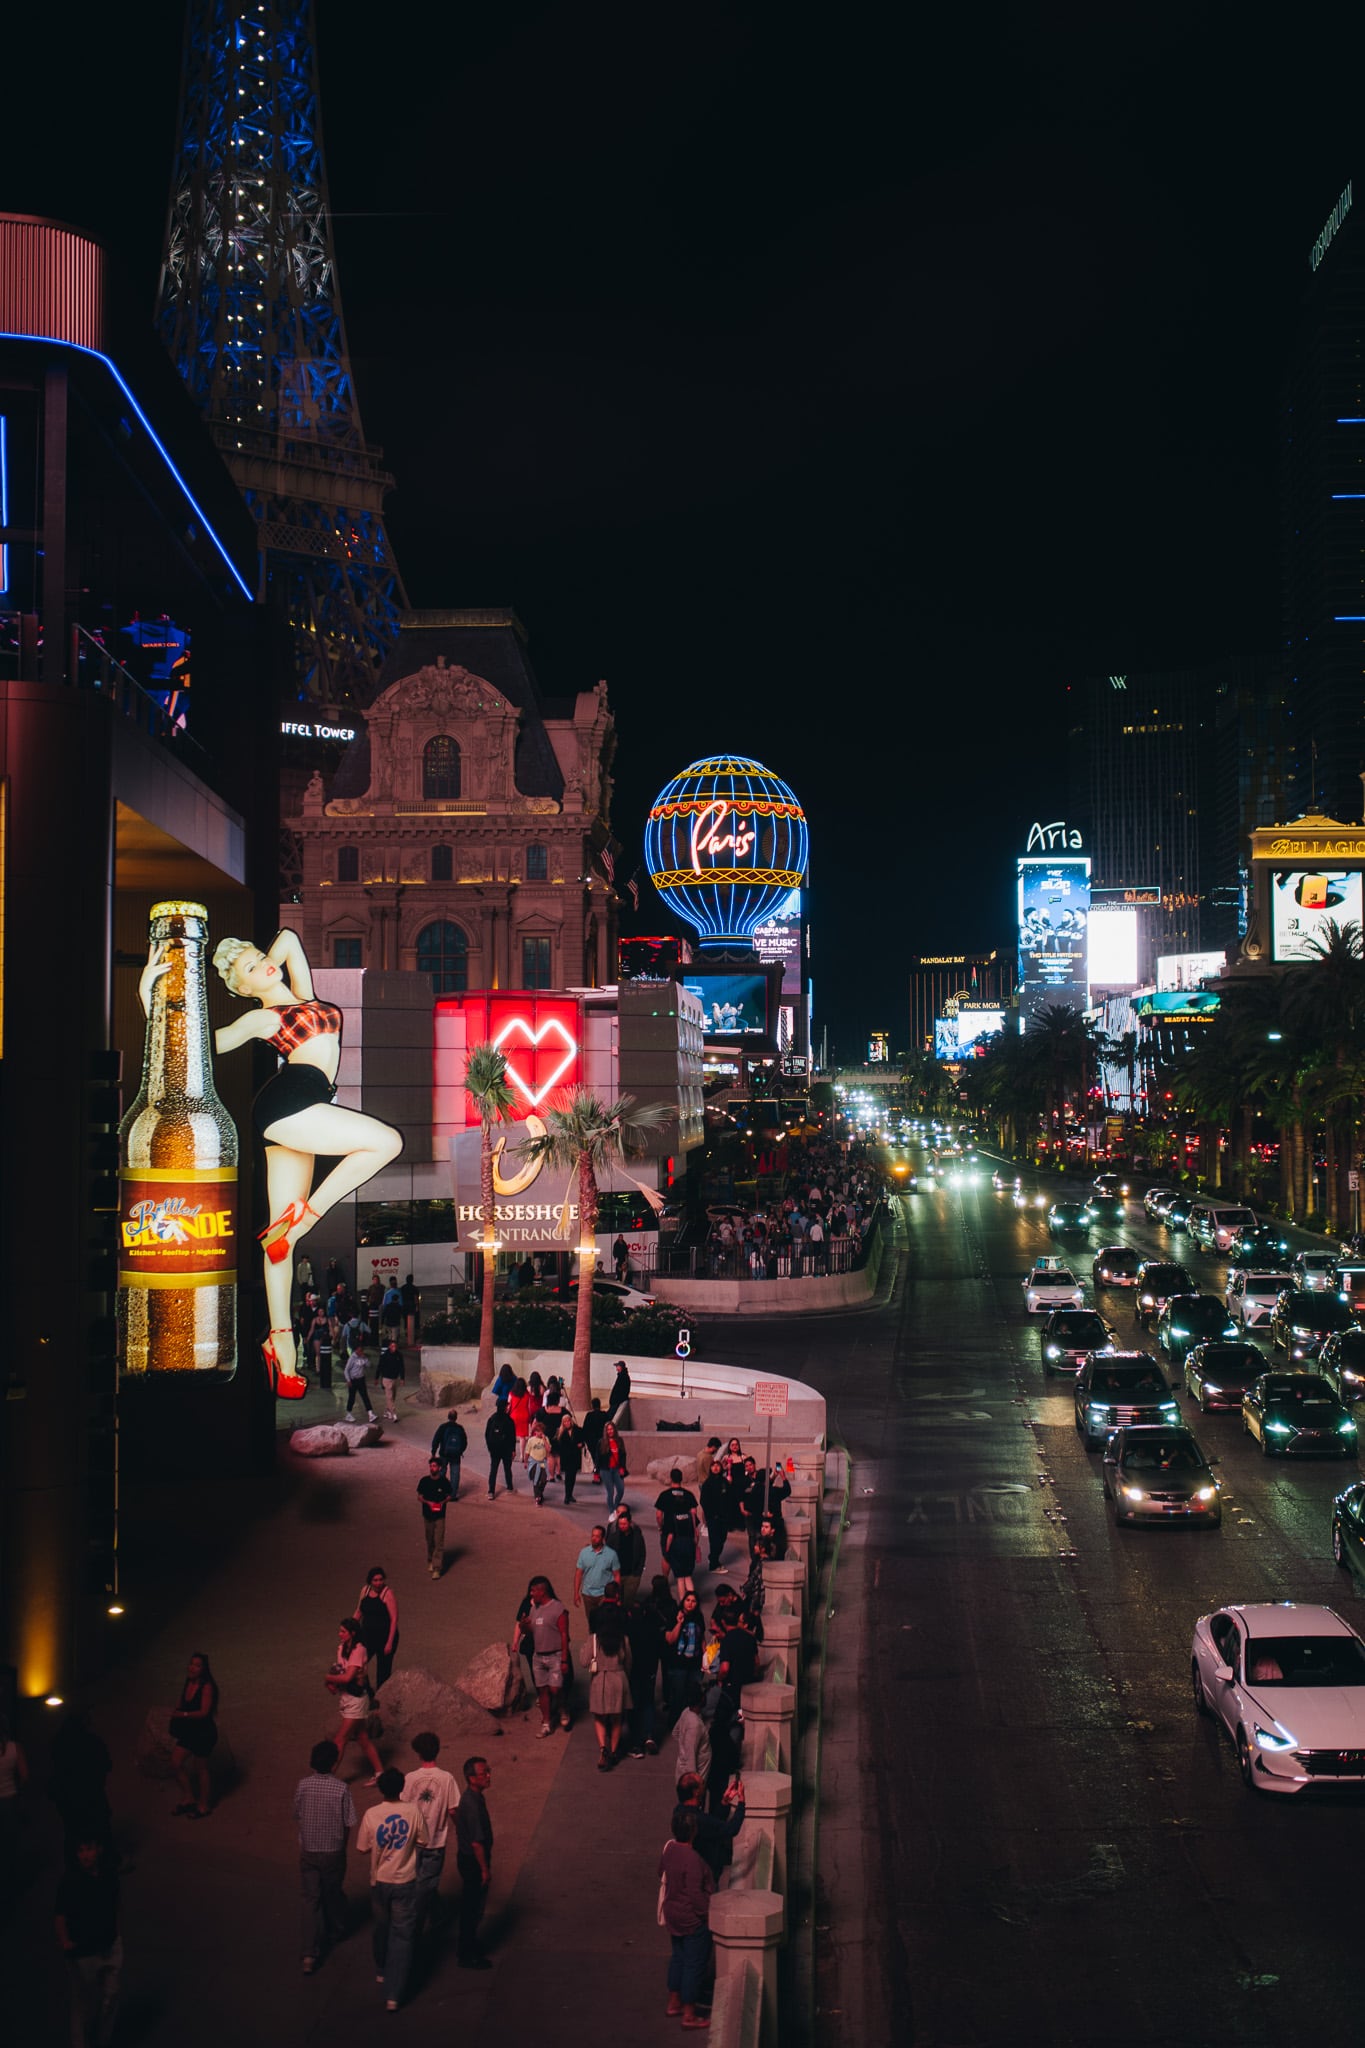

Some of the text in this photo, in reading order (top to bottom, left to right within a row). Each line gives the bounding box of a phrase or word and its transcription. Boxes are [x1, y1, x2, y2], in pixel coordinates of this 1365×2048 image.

[281, 722, 355, 741] IFFEL TOWER
[692, 800, 756, 876] Paris
[1026, 821, 1083, 852] Aria
[755, 938, 797, 947] VE MUSIC
[380, 1257, 400, 1267] CVS
